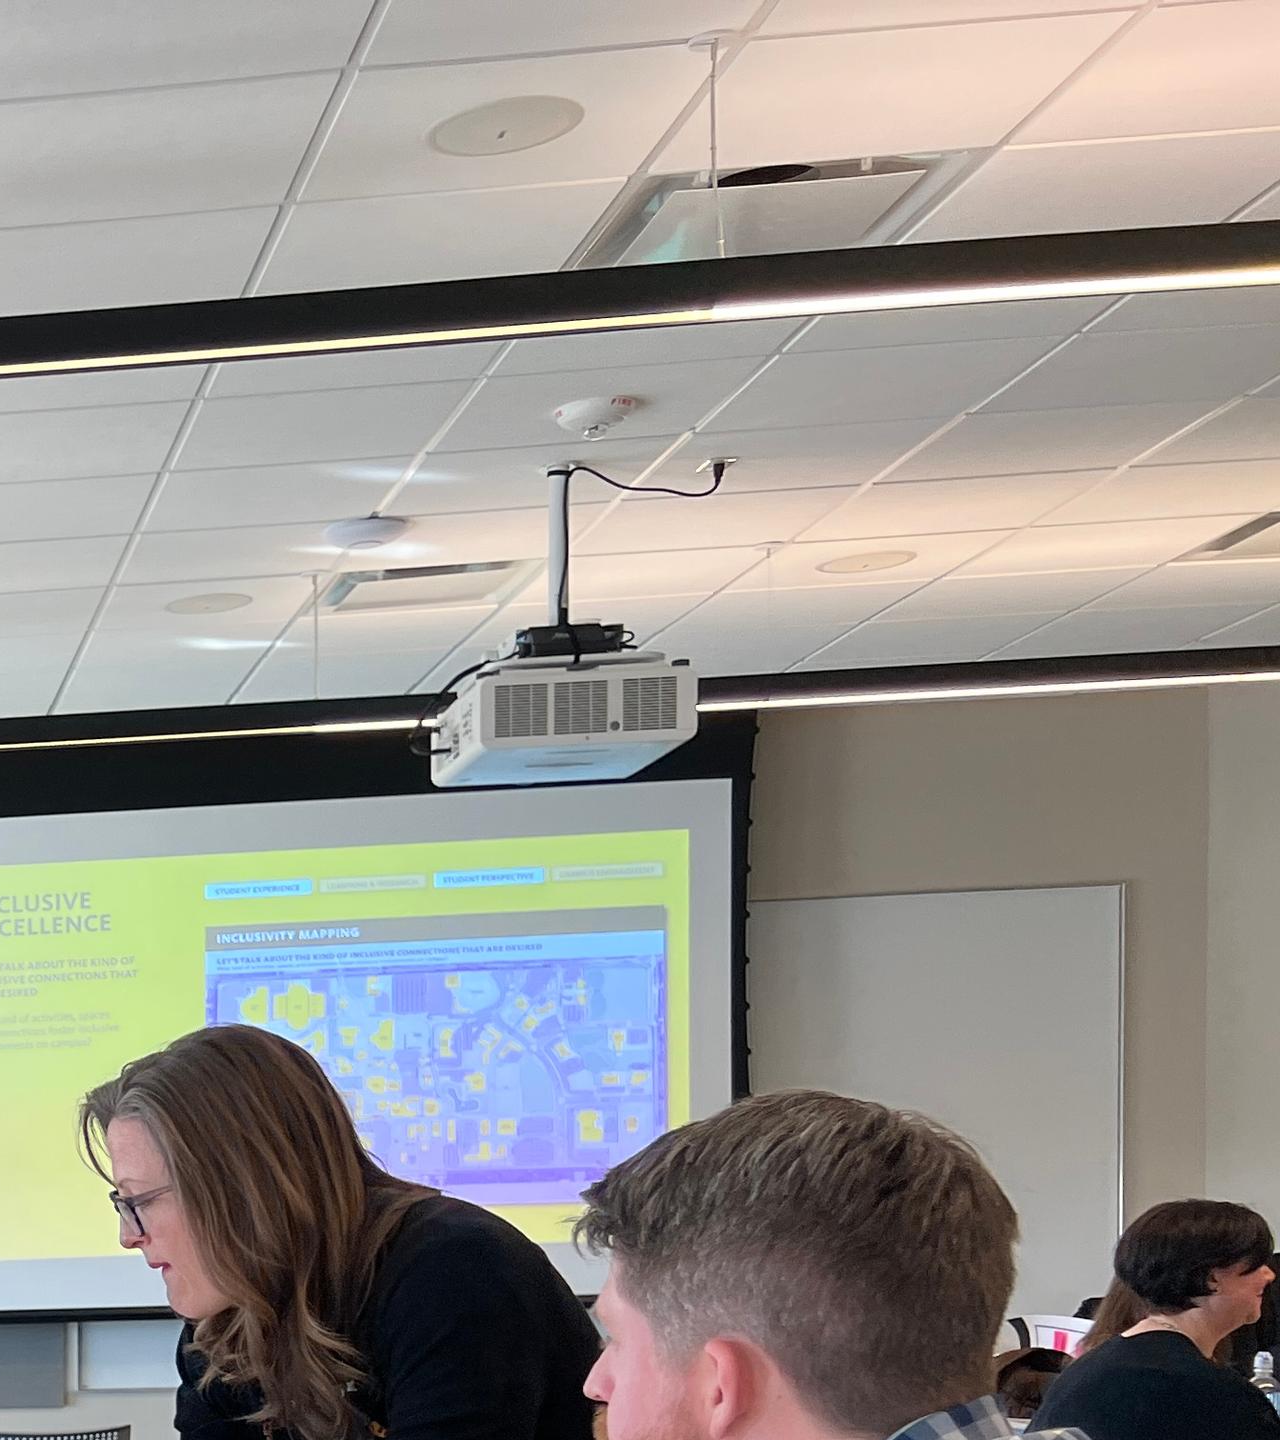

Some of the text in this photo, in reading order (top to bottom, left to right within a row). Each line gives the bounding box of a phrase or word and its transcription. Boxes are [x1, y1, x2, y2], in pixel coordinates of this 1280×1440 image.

[216, 926, 361, 945] INCLUSIVITY MAPPING
[27, 959, 65, 971] ABOUT
[66, 957, 88, 969] THE
[90, 956, 118, 968] KIND
[119, 955, 136, 966] OF
[27, 970, 108, 984] CONNECTIONS
[108, 968, 140, 980] THAT
